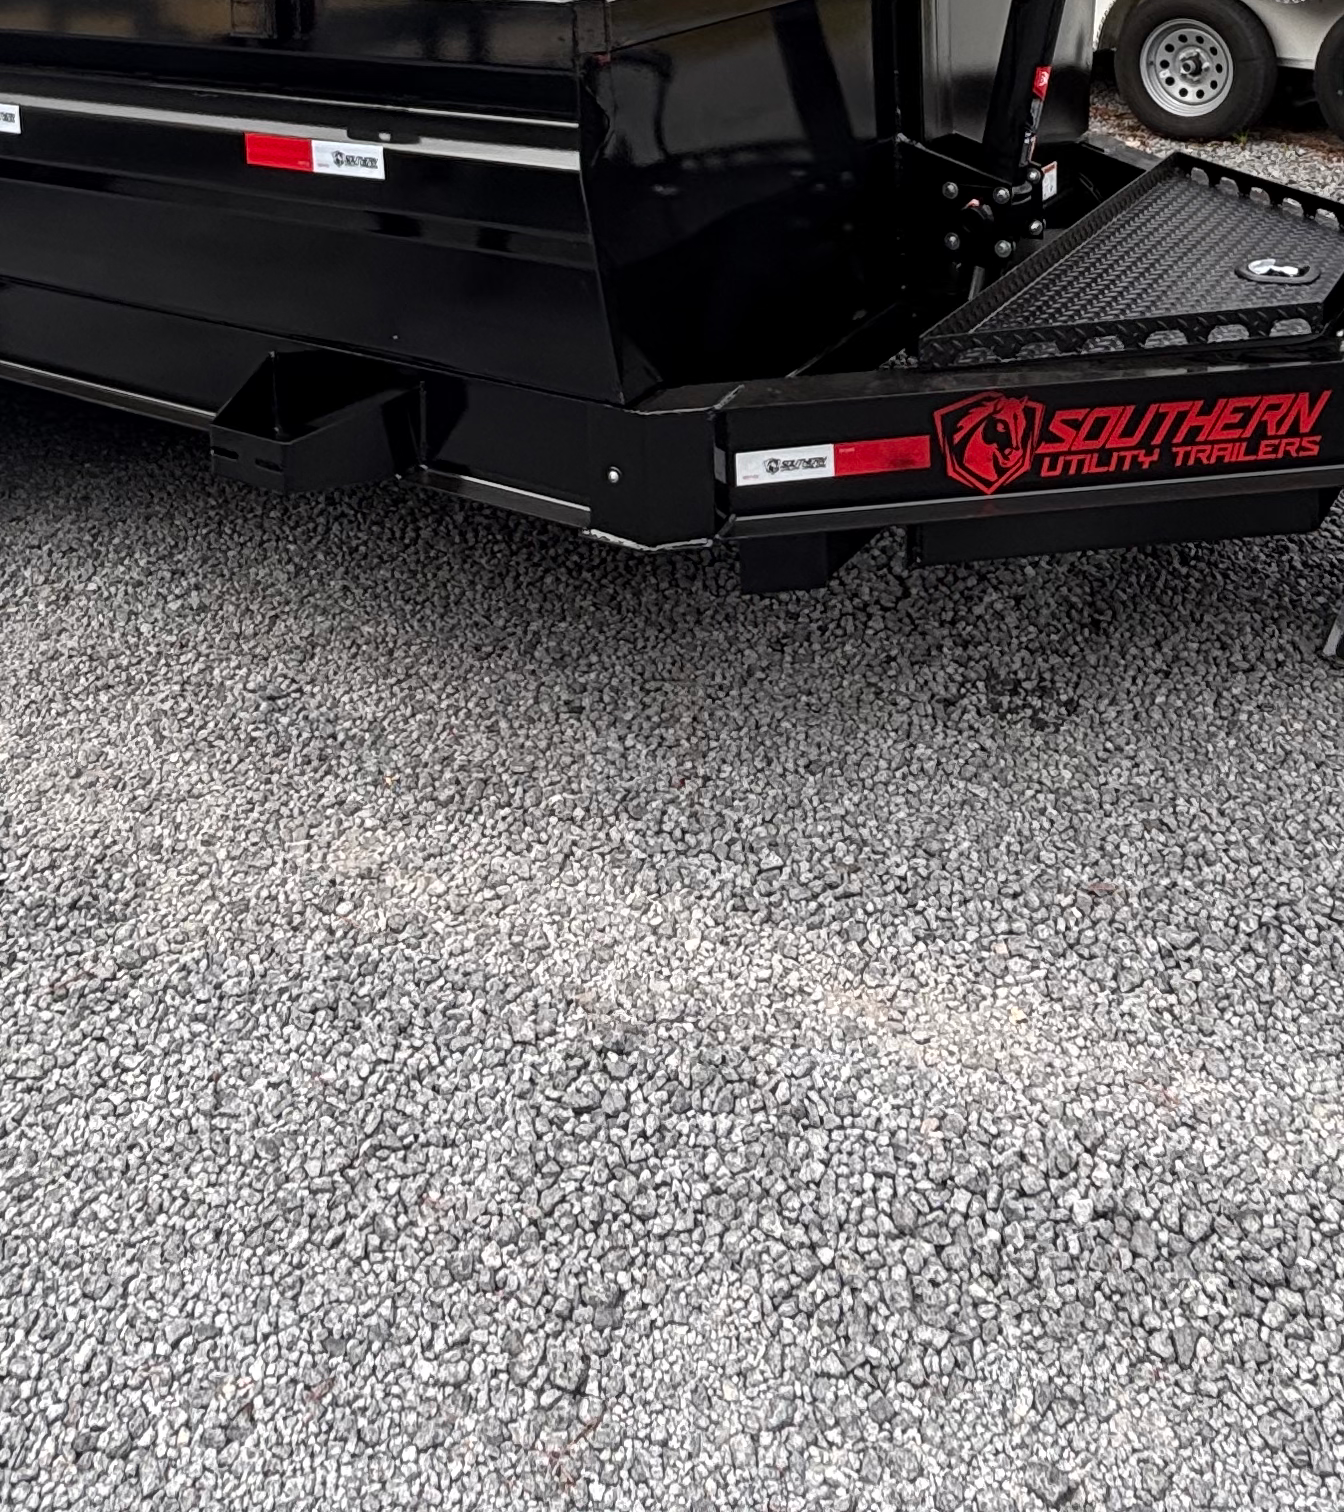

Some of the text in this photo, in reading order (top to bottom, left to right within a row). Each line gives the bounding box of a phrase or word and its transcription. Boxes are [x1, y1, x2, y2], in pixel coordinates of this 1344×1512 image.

[1035, 390, 1333, 454] SOUTHERN
[1040, 435, 1323, 478] UTILITY TRAILERS
